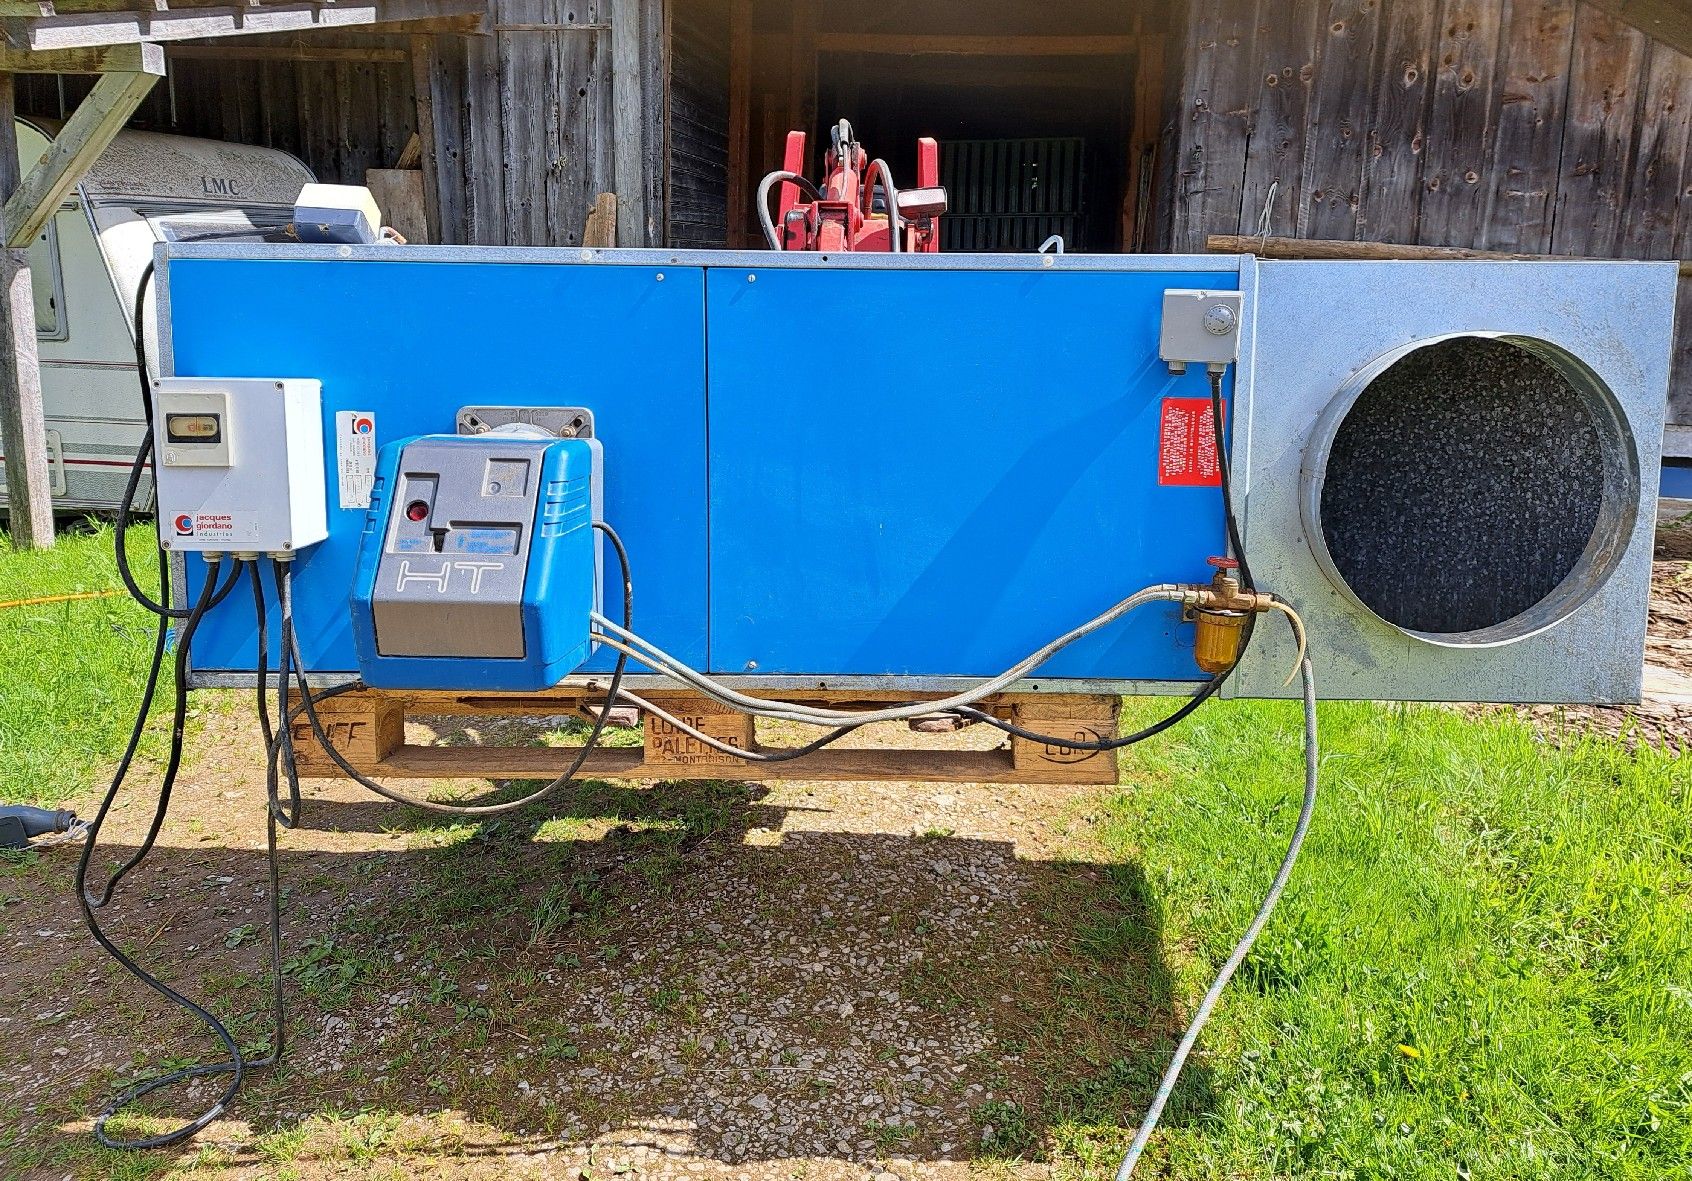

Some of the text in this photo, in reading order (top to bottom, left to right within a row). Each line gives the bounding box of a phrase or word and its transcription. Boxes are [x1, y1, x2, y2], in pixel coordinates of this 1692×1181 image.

[200, 176, 240, 196] LMC
[196, 513, 232, 523] jacques
[196, 521, 233, 531] giordano
[396, 560, 504, 594] HT
[651, 716, 706, 734] LORE
